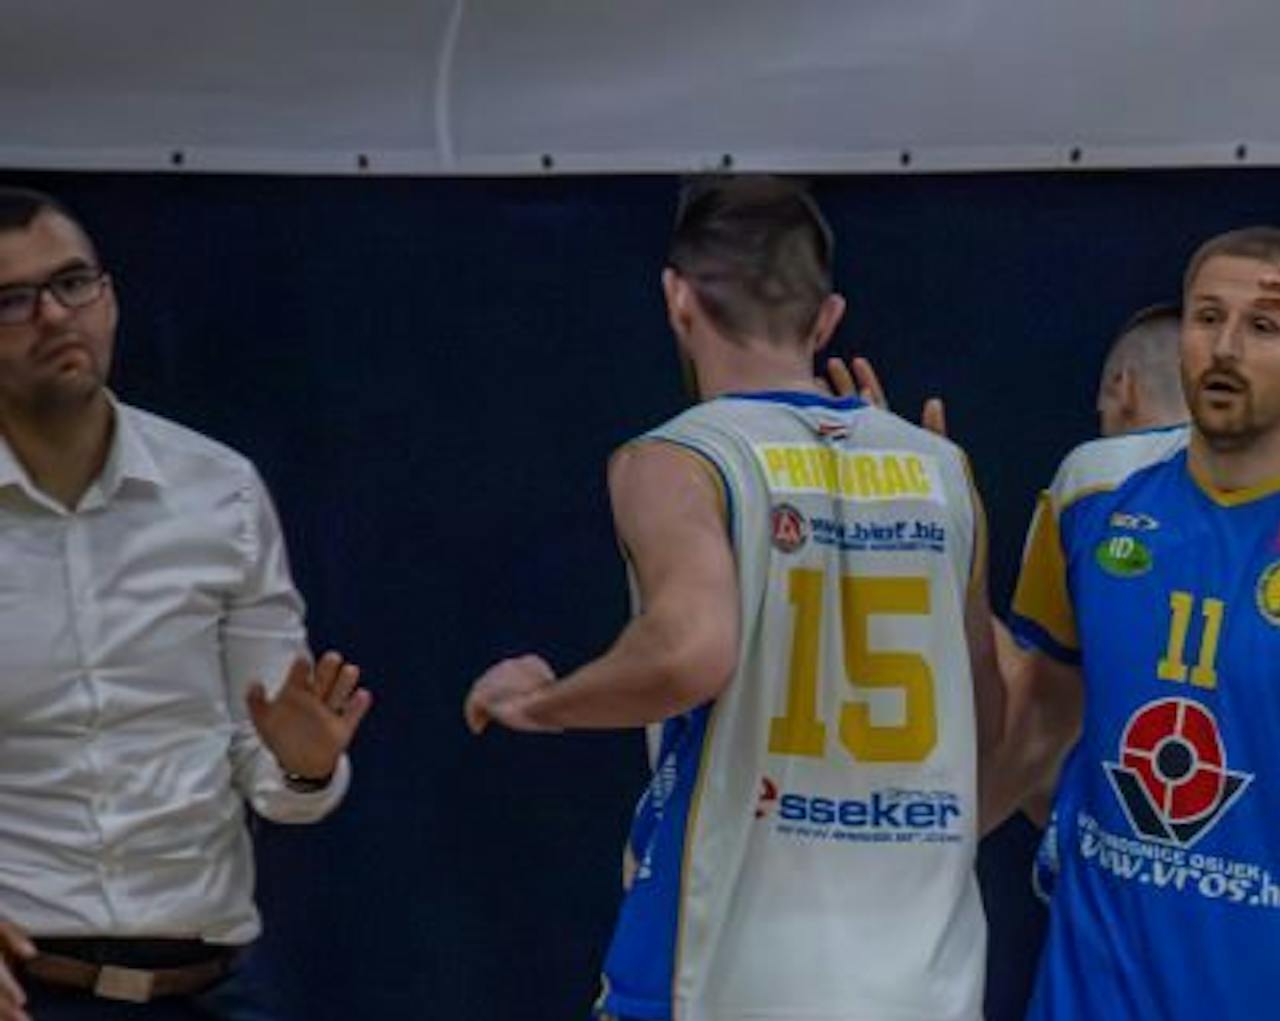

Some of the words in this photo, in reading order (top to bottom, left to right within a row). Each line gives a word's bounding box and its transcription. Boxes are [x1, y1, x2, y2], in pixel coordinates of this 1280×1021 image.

[767, 567, 939, 764] 15
[1156, 590, 1224, 690] 11
[1189, 852, 1260, 881] OSIJEK
